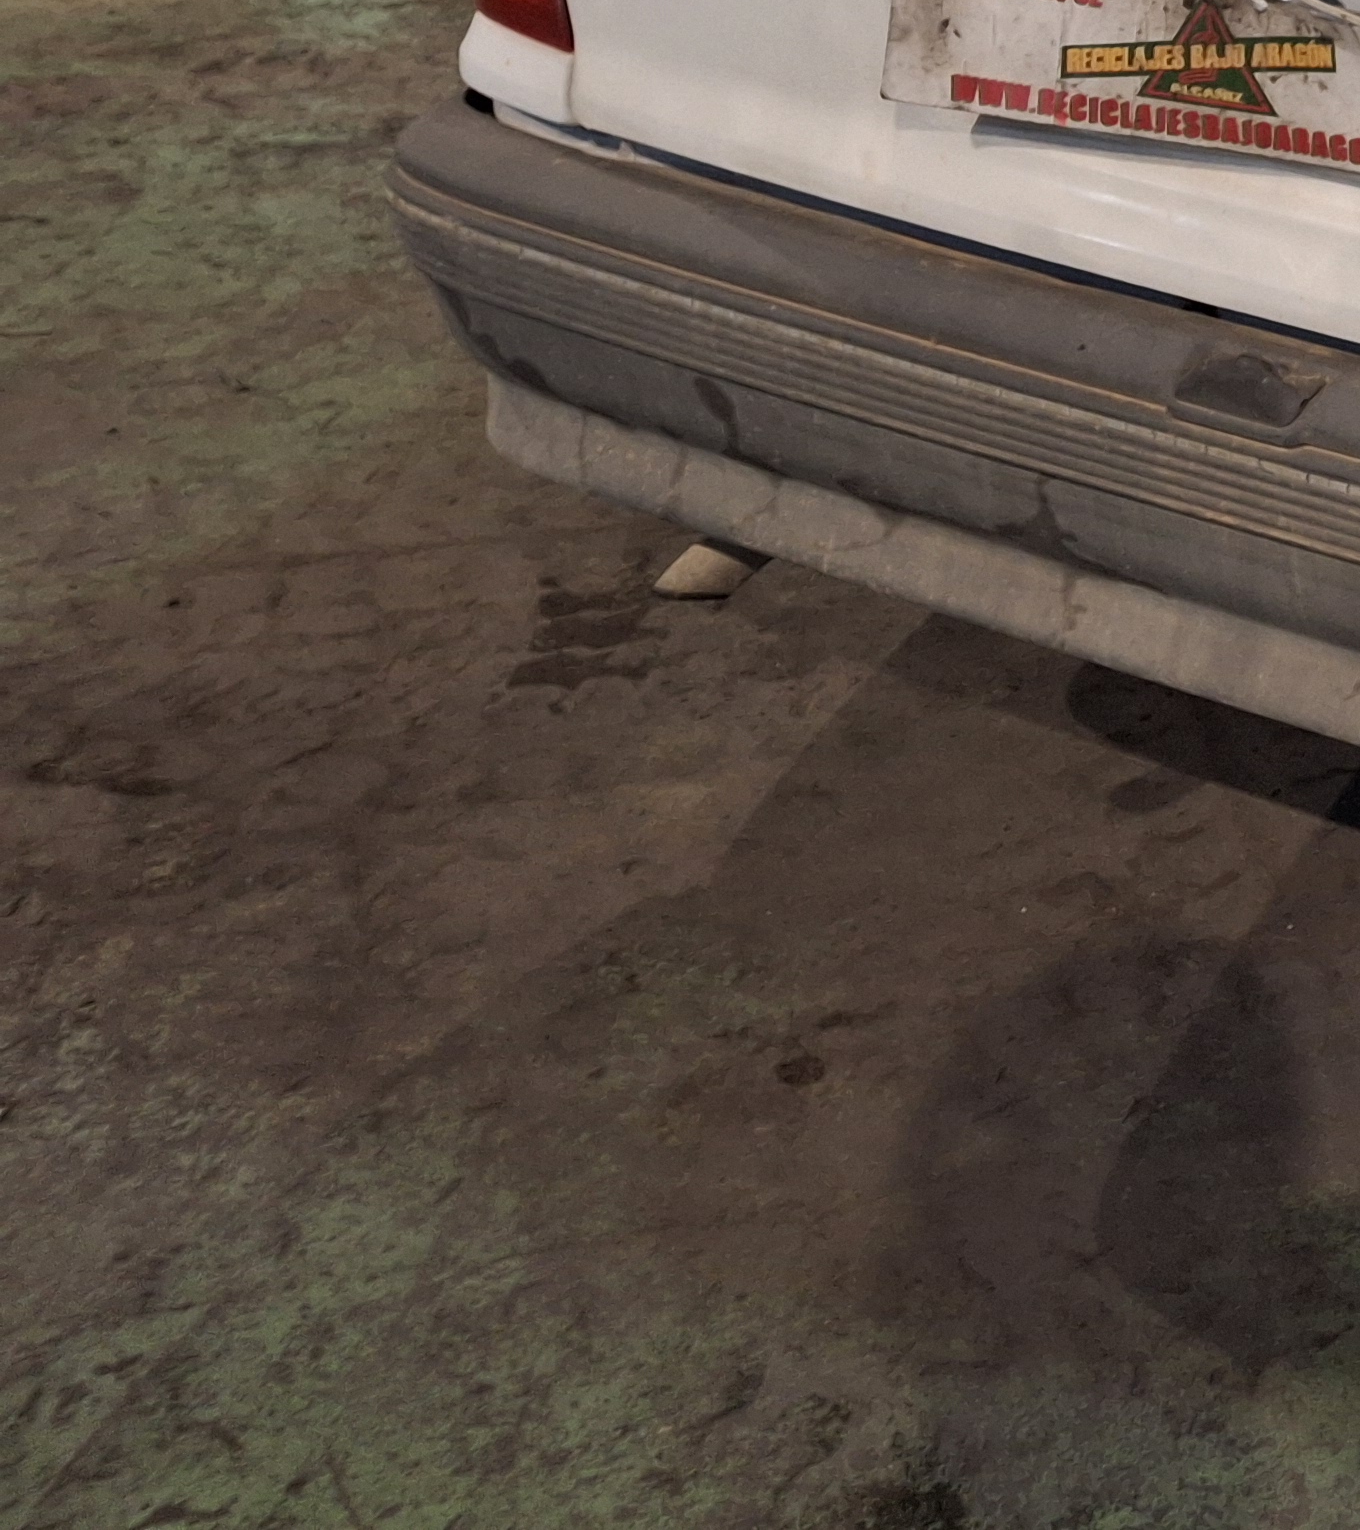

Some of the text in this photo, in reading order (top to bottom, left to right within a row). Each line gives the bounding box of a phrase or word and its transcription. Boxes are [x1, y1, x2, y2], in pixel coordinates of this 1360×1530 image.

[1066, 39, 1333, 73] RECICLAJES BAJO ARAGÓN
